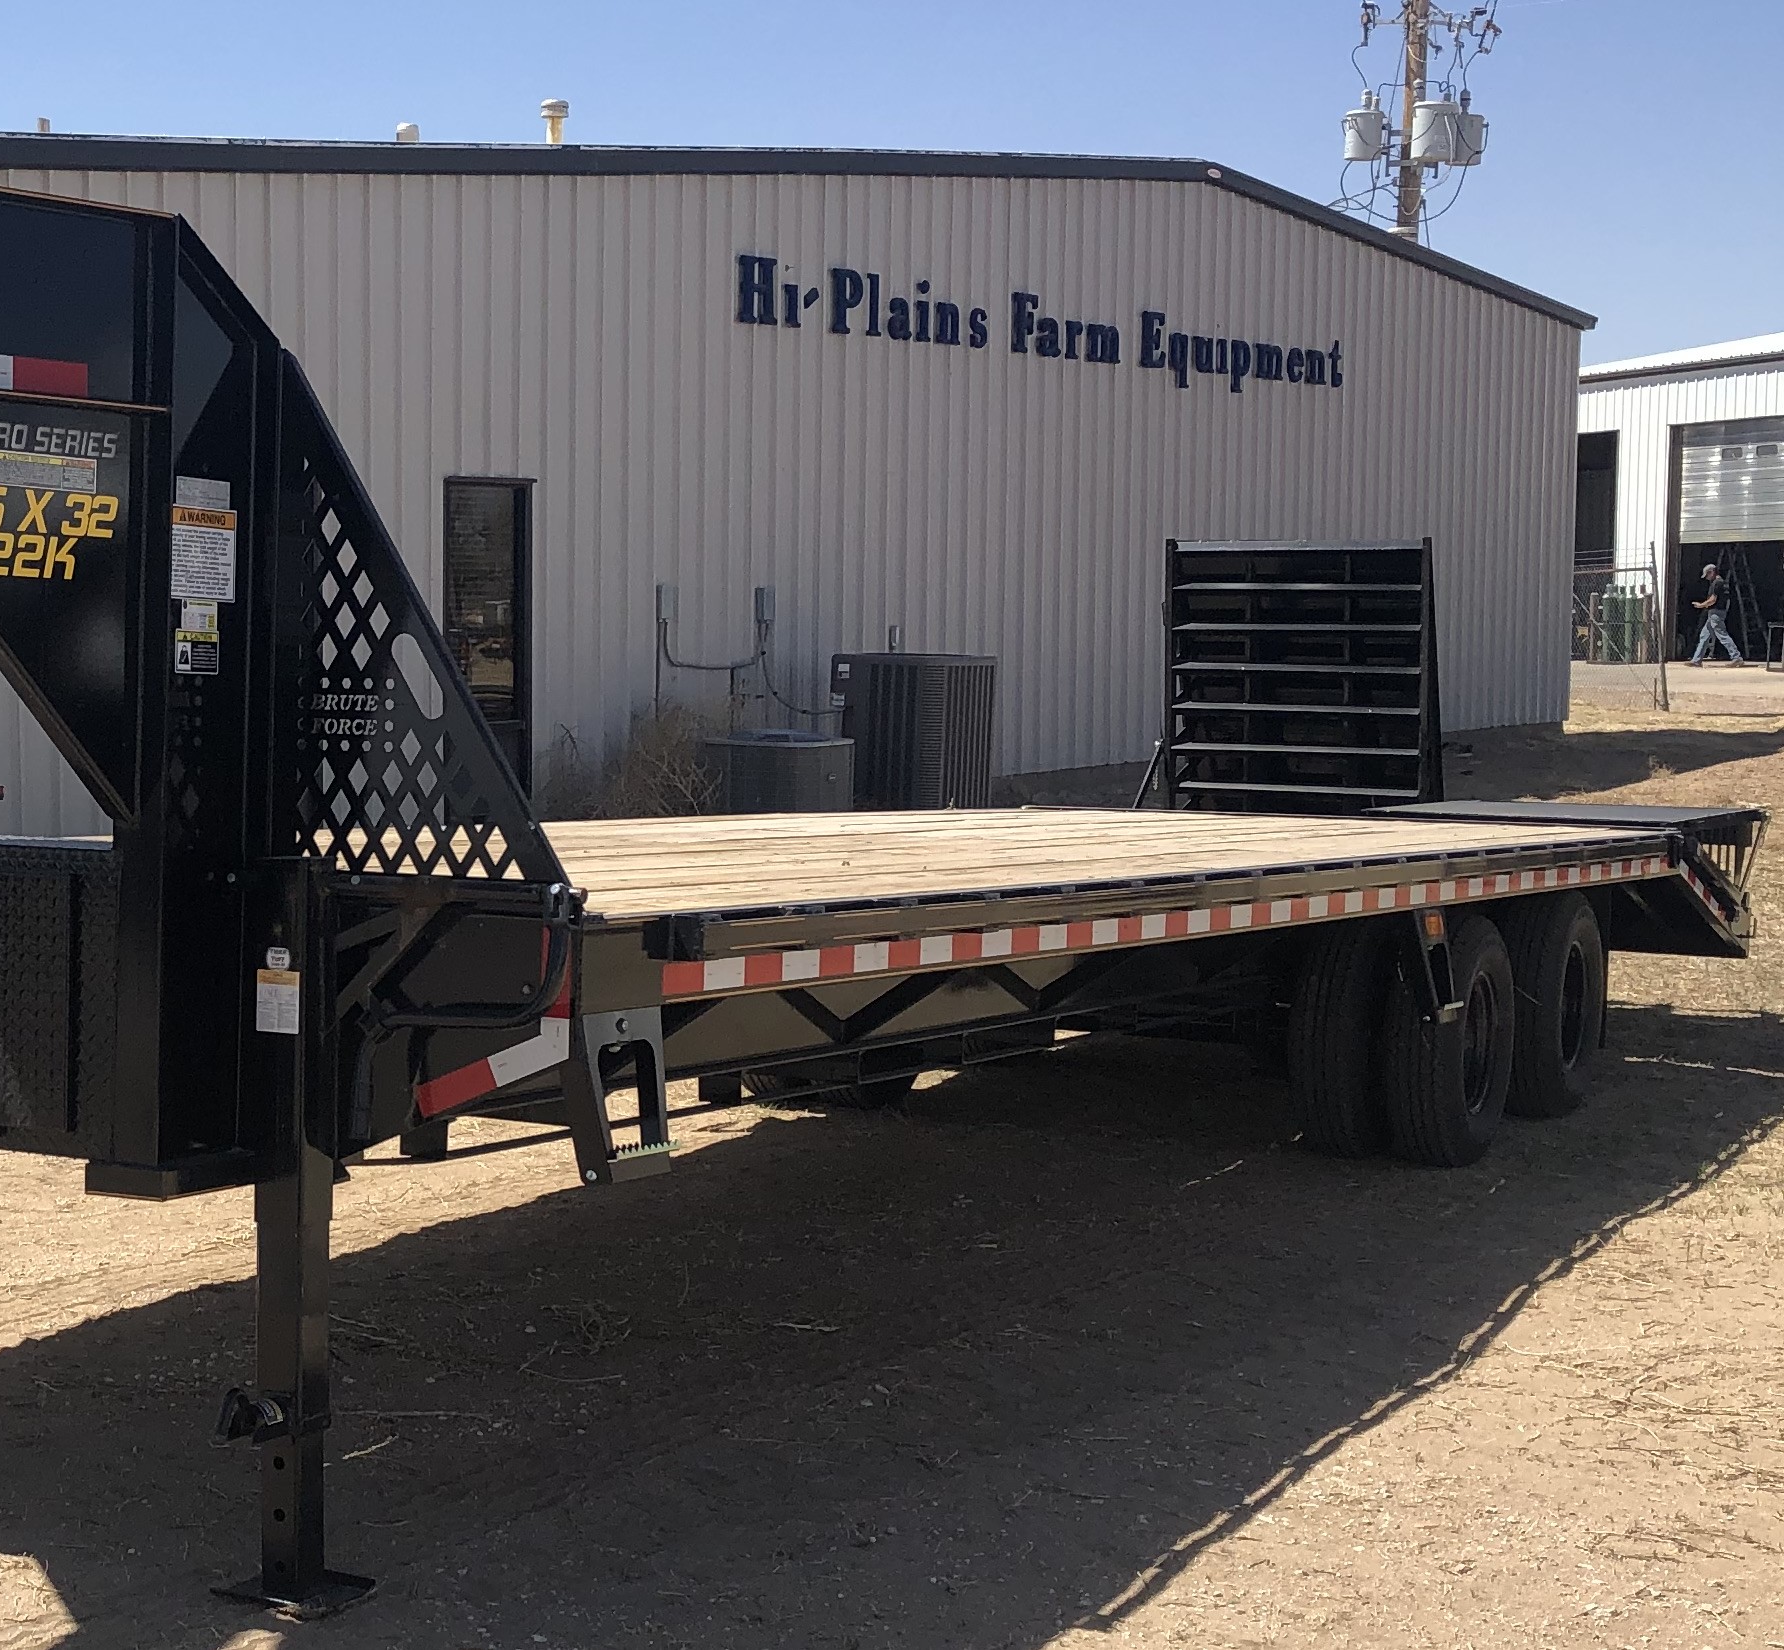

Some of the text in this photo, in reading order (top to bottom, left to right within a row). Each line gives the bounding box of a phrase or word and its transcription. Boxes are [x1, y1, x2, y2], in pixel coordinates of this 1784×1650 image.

[1011, 291, 1121, 365] Farm
[1139, 310, 1343, 393] Equipment
[34, 426, 118, 458] SERIES
[16, 489, 54, 534] X
[61, 494, 119, 538] 32
[188, 510, 226, 526] WARNING
[311, 694, 379, 711] BRUTE
[311, 718, 377, 735] FORCE
